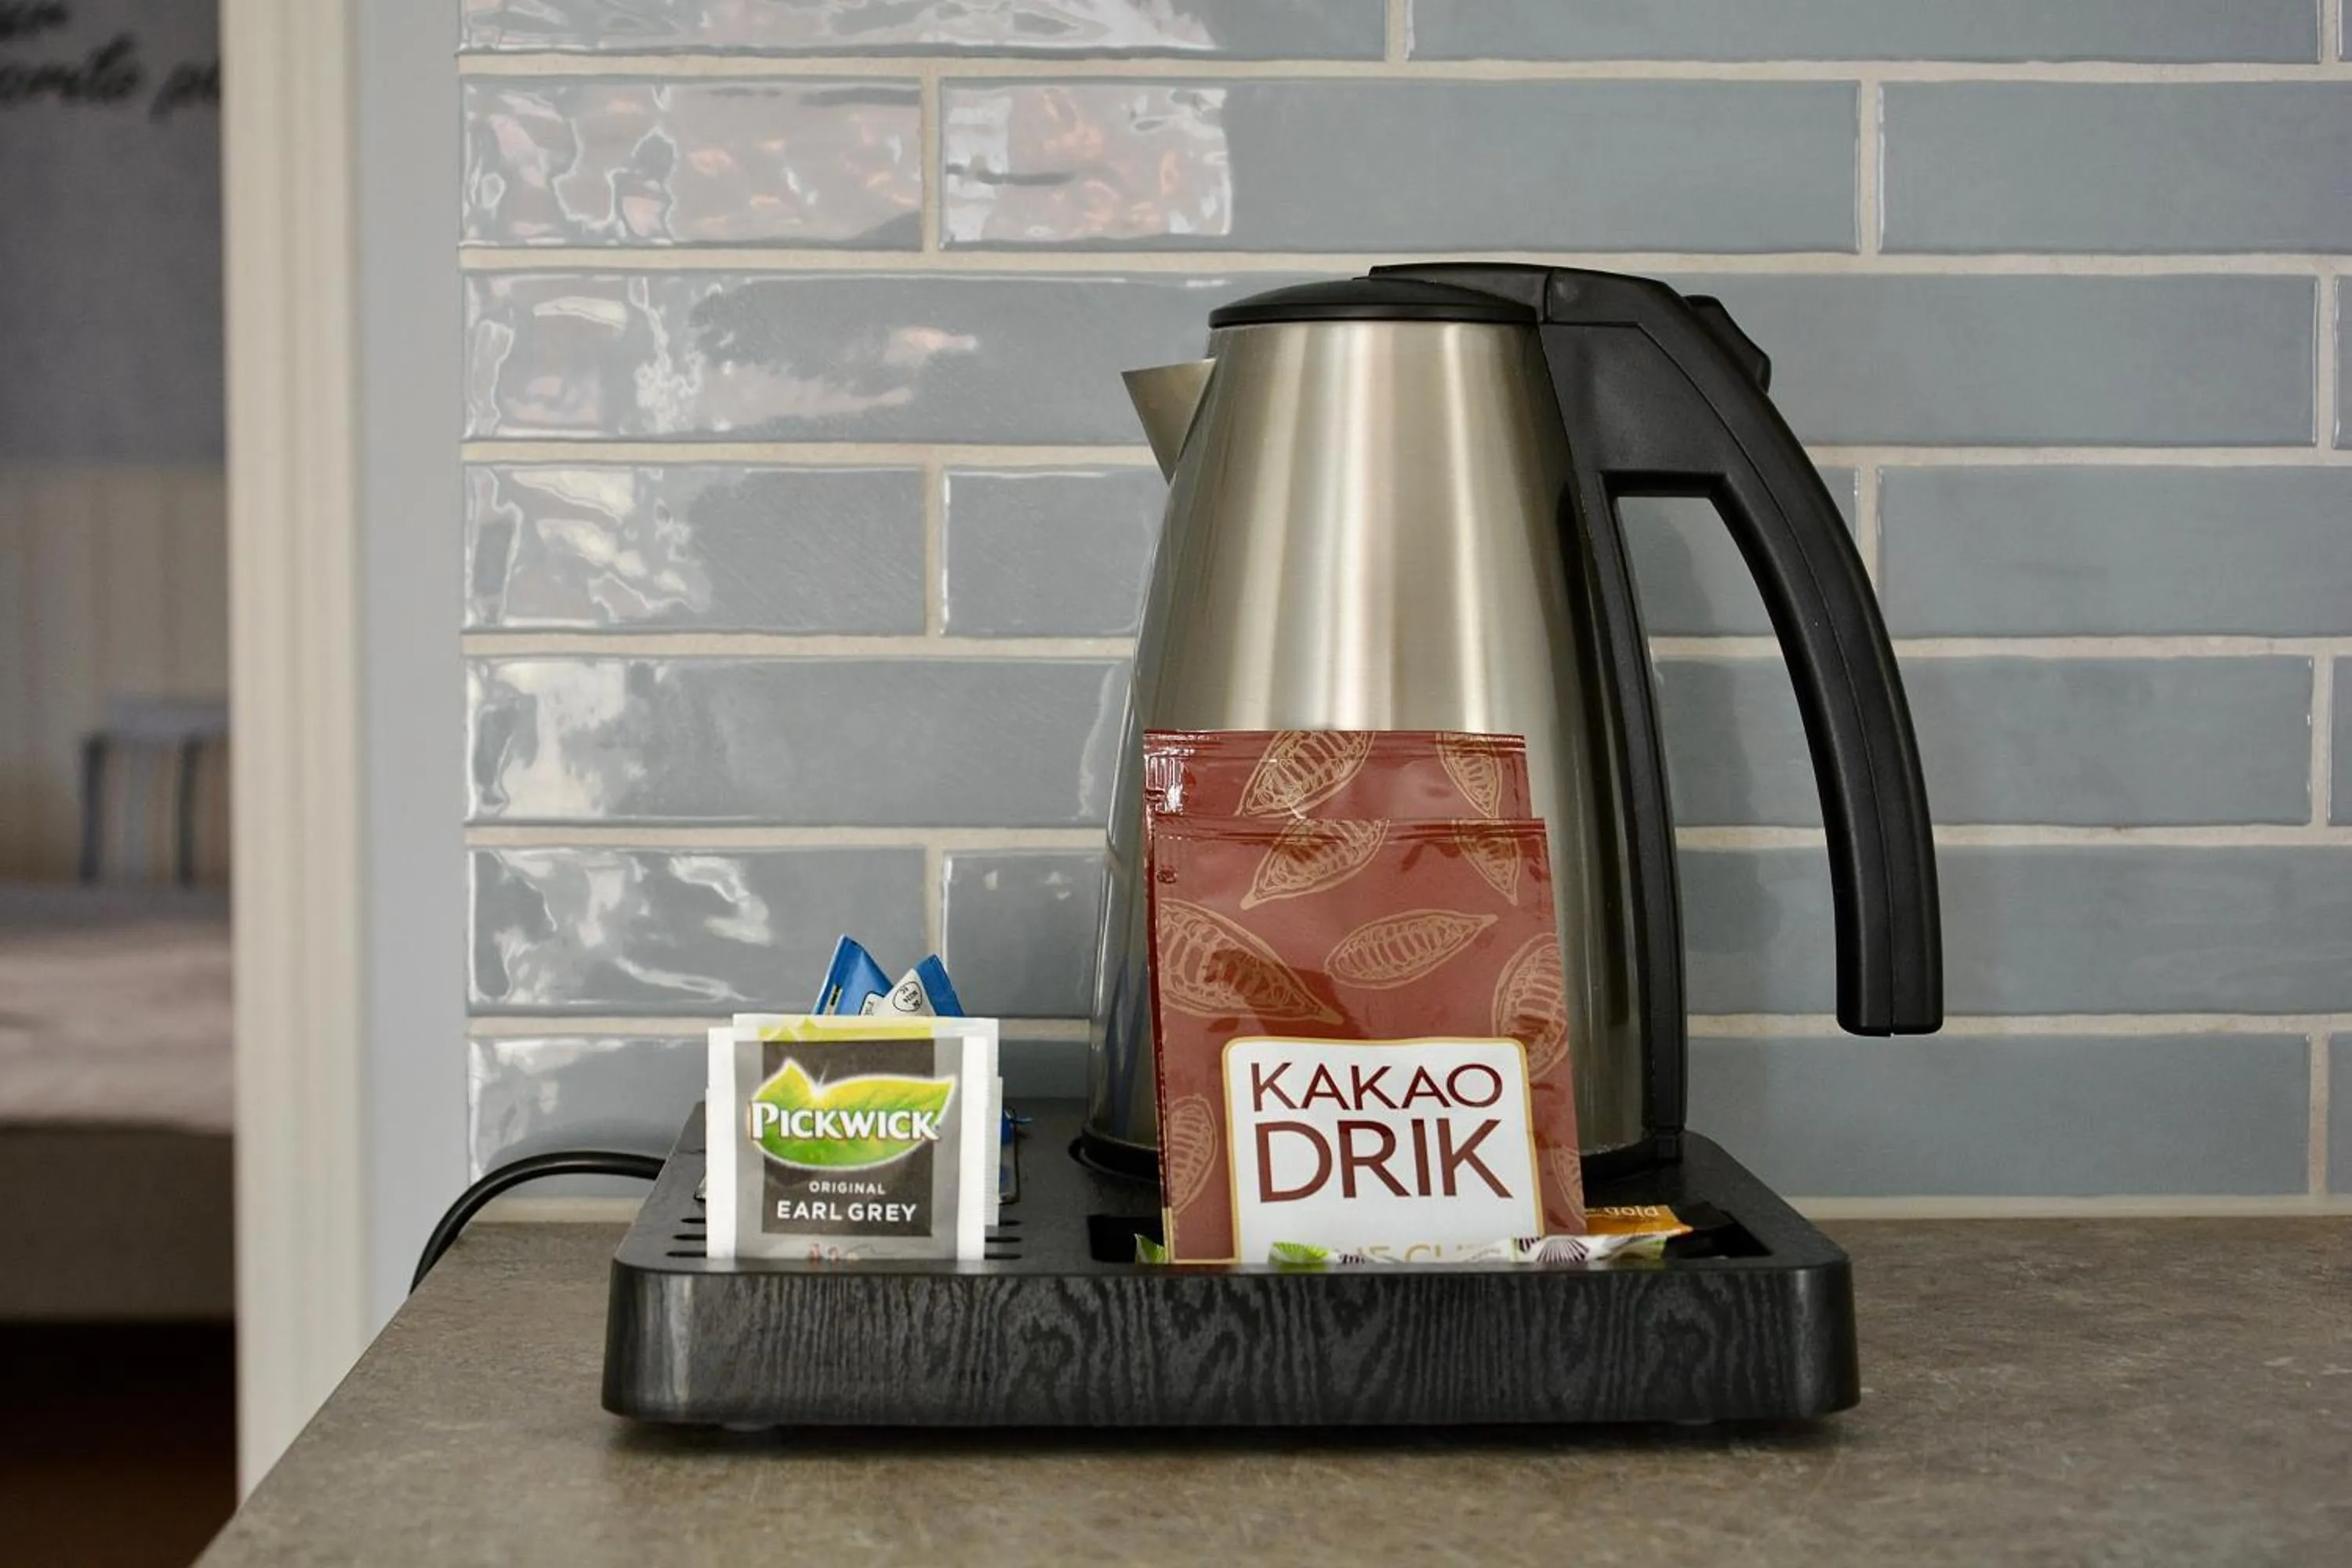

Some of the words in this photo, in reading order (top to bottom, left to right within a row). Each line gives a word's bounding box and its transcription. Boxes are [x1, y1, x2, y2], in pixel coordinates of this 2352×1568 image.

[1250, 1062, 1504, 1112] KAKAO
[750, 1102, 940, 1141] PICKWICK
[1255, 1117, 1513, 1203] DRIK
[808, 1181, 887, 1196] ORIGINAL
[777, 1200, 844, 1221] EARL
[847, 1202, 917, 1222] GREY
